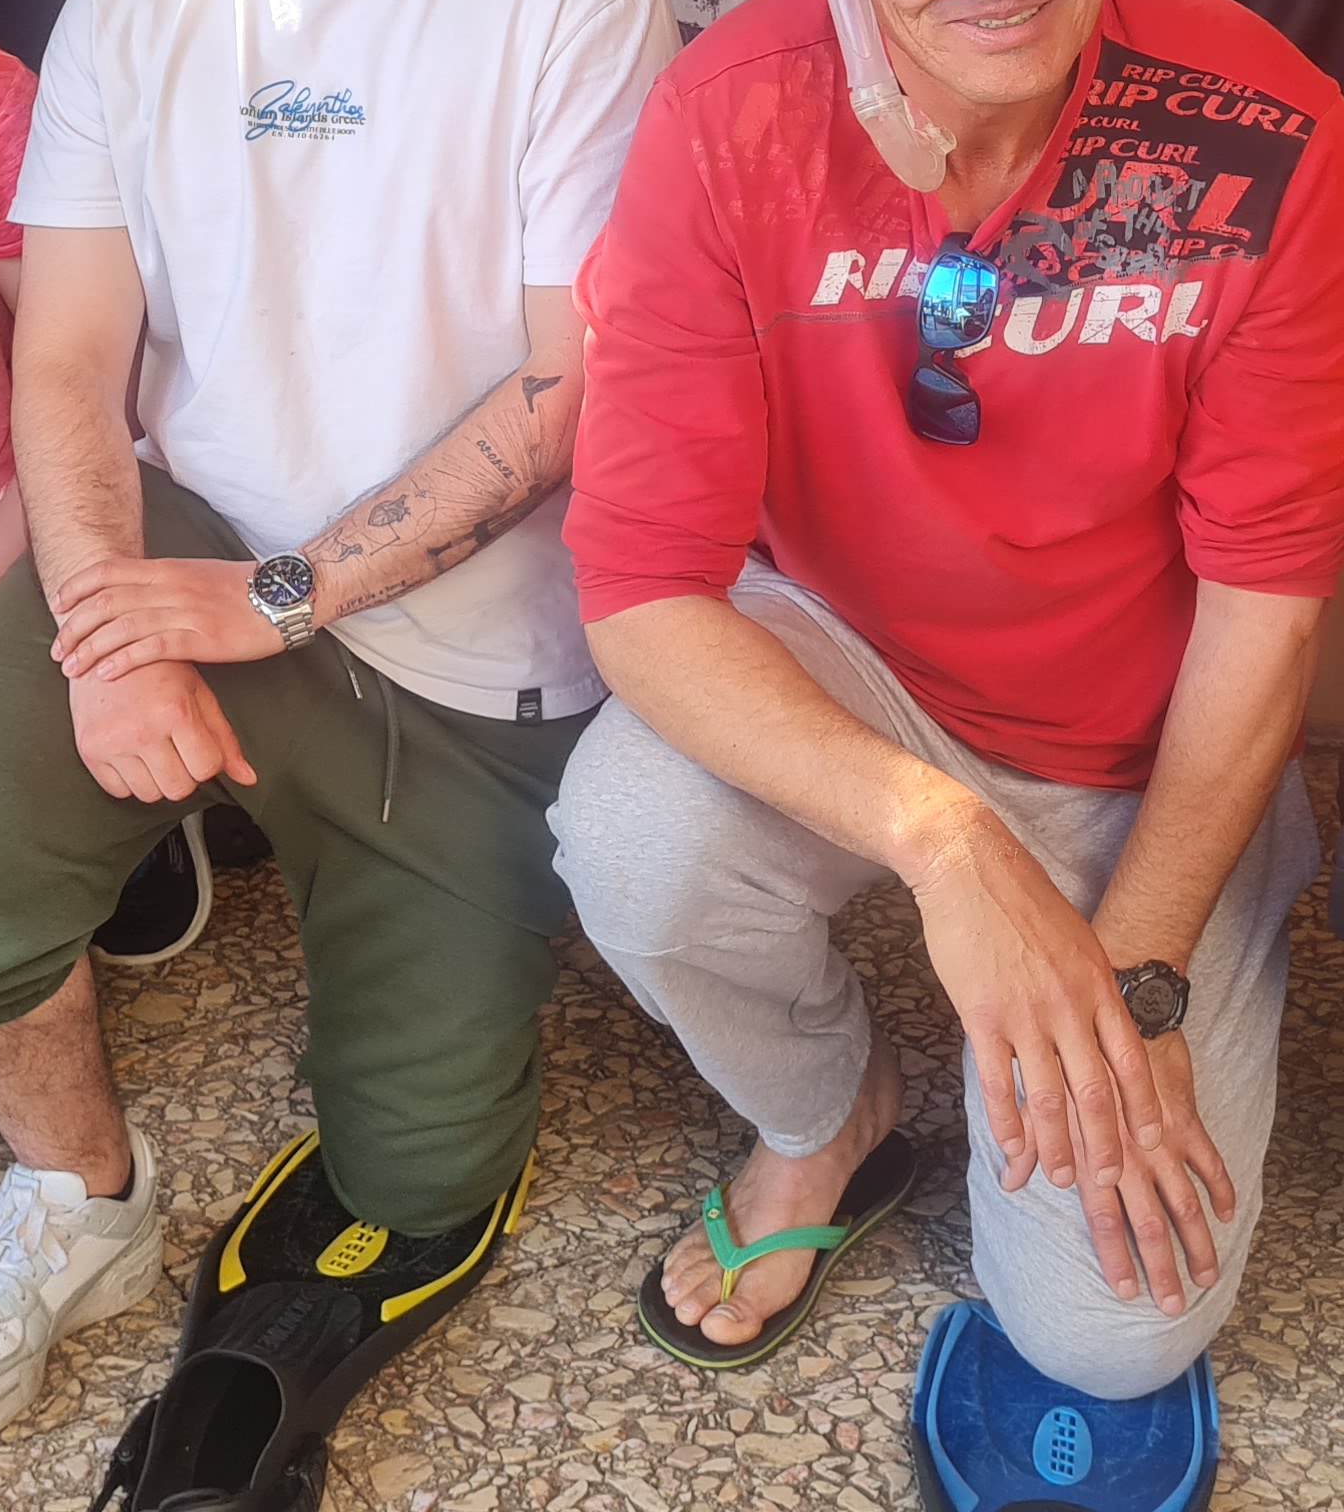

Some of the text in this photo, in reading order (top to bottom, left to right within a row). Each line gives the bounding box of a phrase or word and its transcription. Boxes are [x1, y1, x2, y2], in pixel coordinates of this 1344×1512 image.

[1122, 63, 1260, 99] RIP CURL
[1091, 115, 1141, 131] CURL
[1166, 91, 1311, 140] CURL
[1109, 138, 1201, 165] CURL
